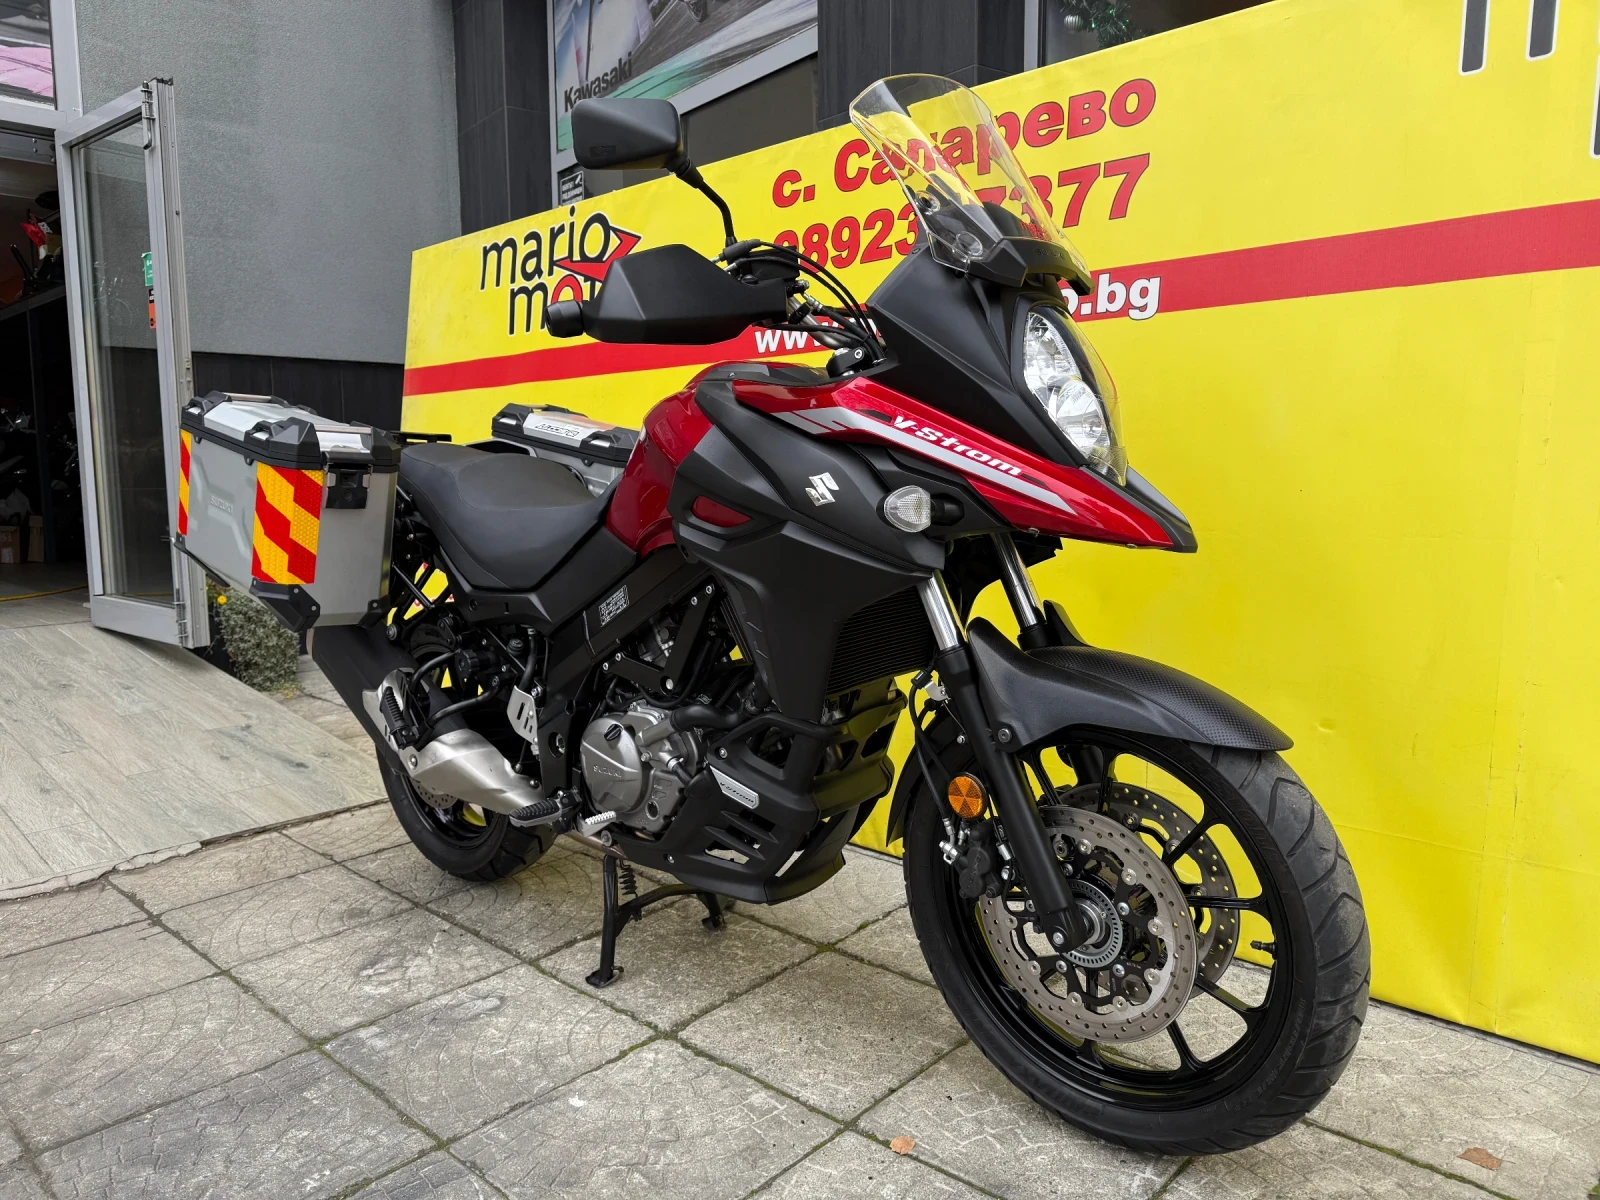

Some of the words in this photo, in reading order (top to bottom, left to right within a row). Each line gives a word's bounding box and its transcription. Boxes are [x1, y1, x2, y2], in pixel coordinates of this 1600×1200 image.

[564, 51, 632, 112] Kawasaki
[480, 205, 611, 290] mario
[592, 764, 622, 778] SUZUKI
